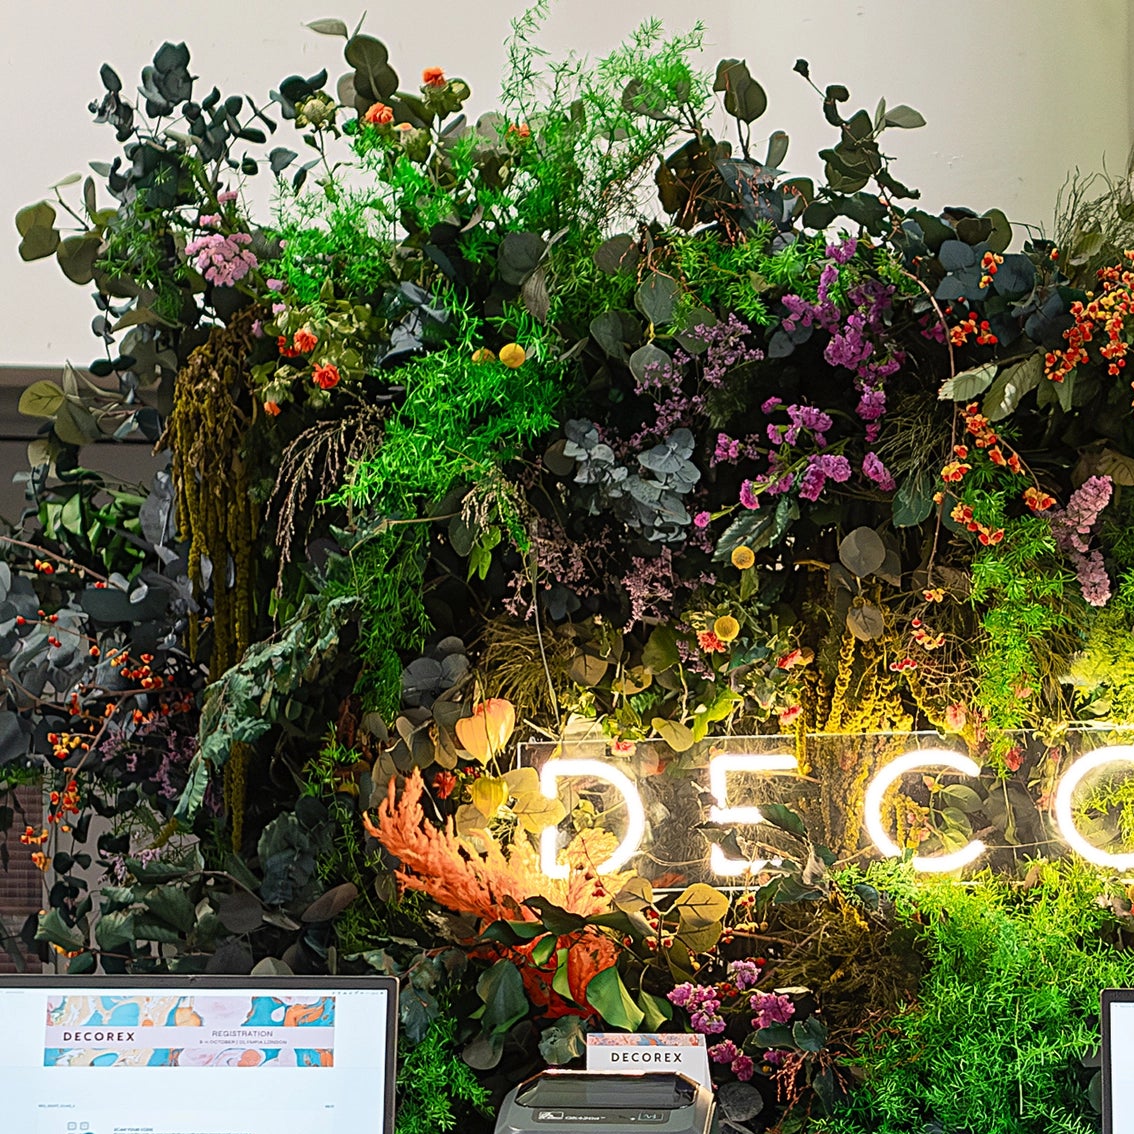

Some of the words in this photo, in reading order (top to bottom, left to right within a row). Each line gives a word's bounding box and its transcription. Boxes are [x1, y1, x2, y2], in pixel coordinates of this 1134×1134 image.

[62, 1031, 136, 1043] DECOREX
[211, 1030, 274, 1038] REGISTRATION
[611, 1052, 683, 1063] DECOREX
